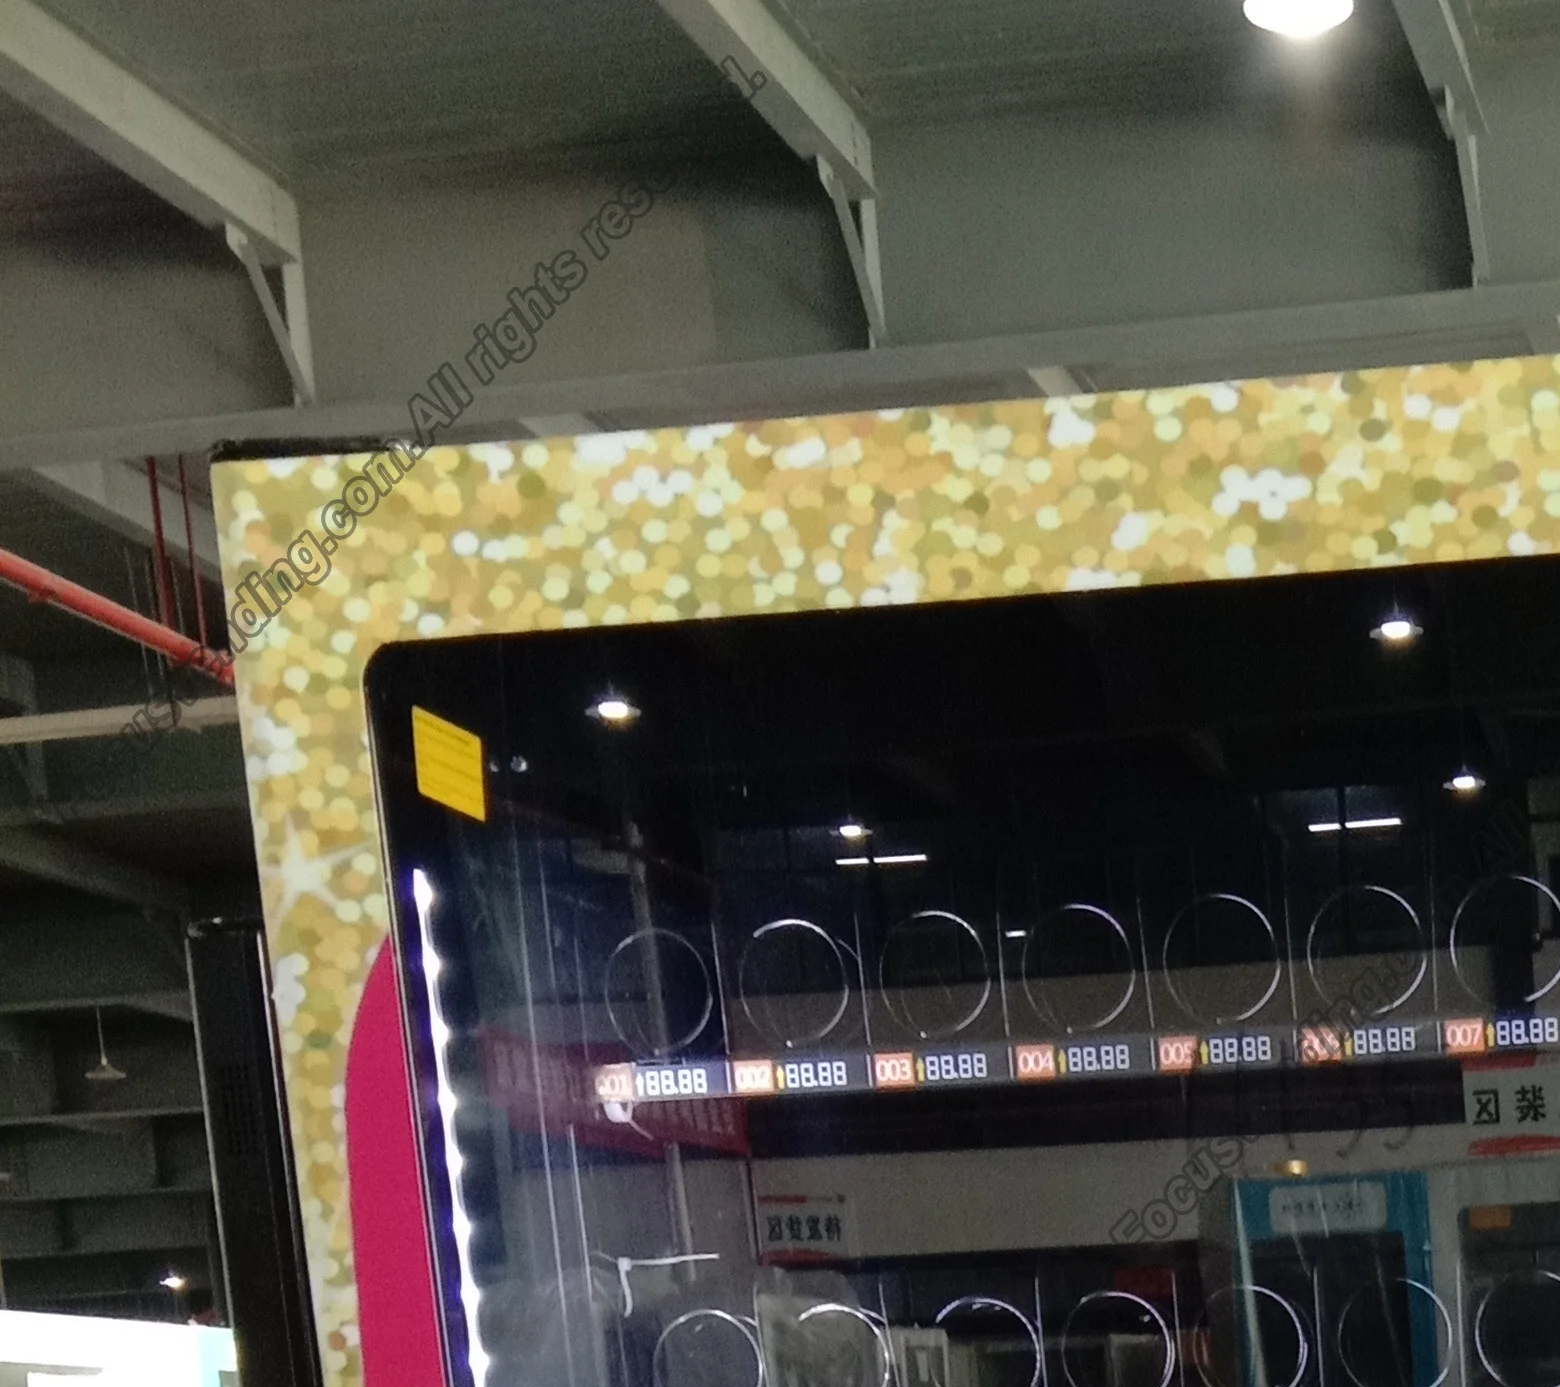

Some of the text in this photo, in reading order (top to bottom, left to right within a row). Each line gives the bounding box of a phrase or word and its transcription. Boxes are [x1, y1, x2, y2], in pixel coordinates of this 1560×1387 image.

[1354, 1026, 1416, 1053] 88.88
[1446, 1017, 1558, 1046] 007 88.88
[1019, 1044, 1130, 1074] 004 88.88
[1209, 1035, 1271, 1063] 88.88
[645, 1068, 708, 1095] 88.88
[786, 1061, 847, 1088] 88.88
[876, 1053, 987, 1082] 003 88.88
